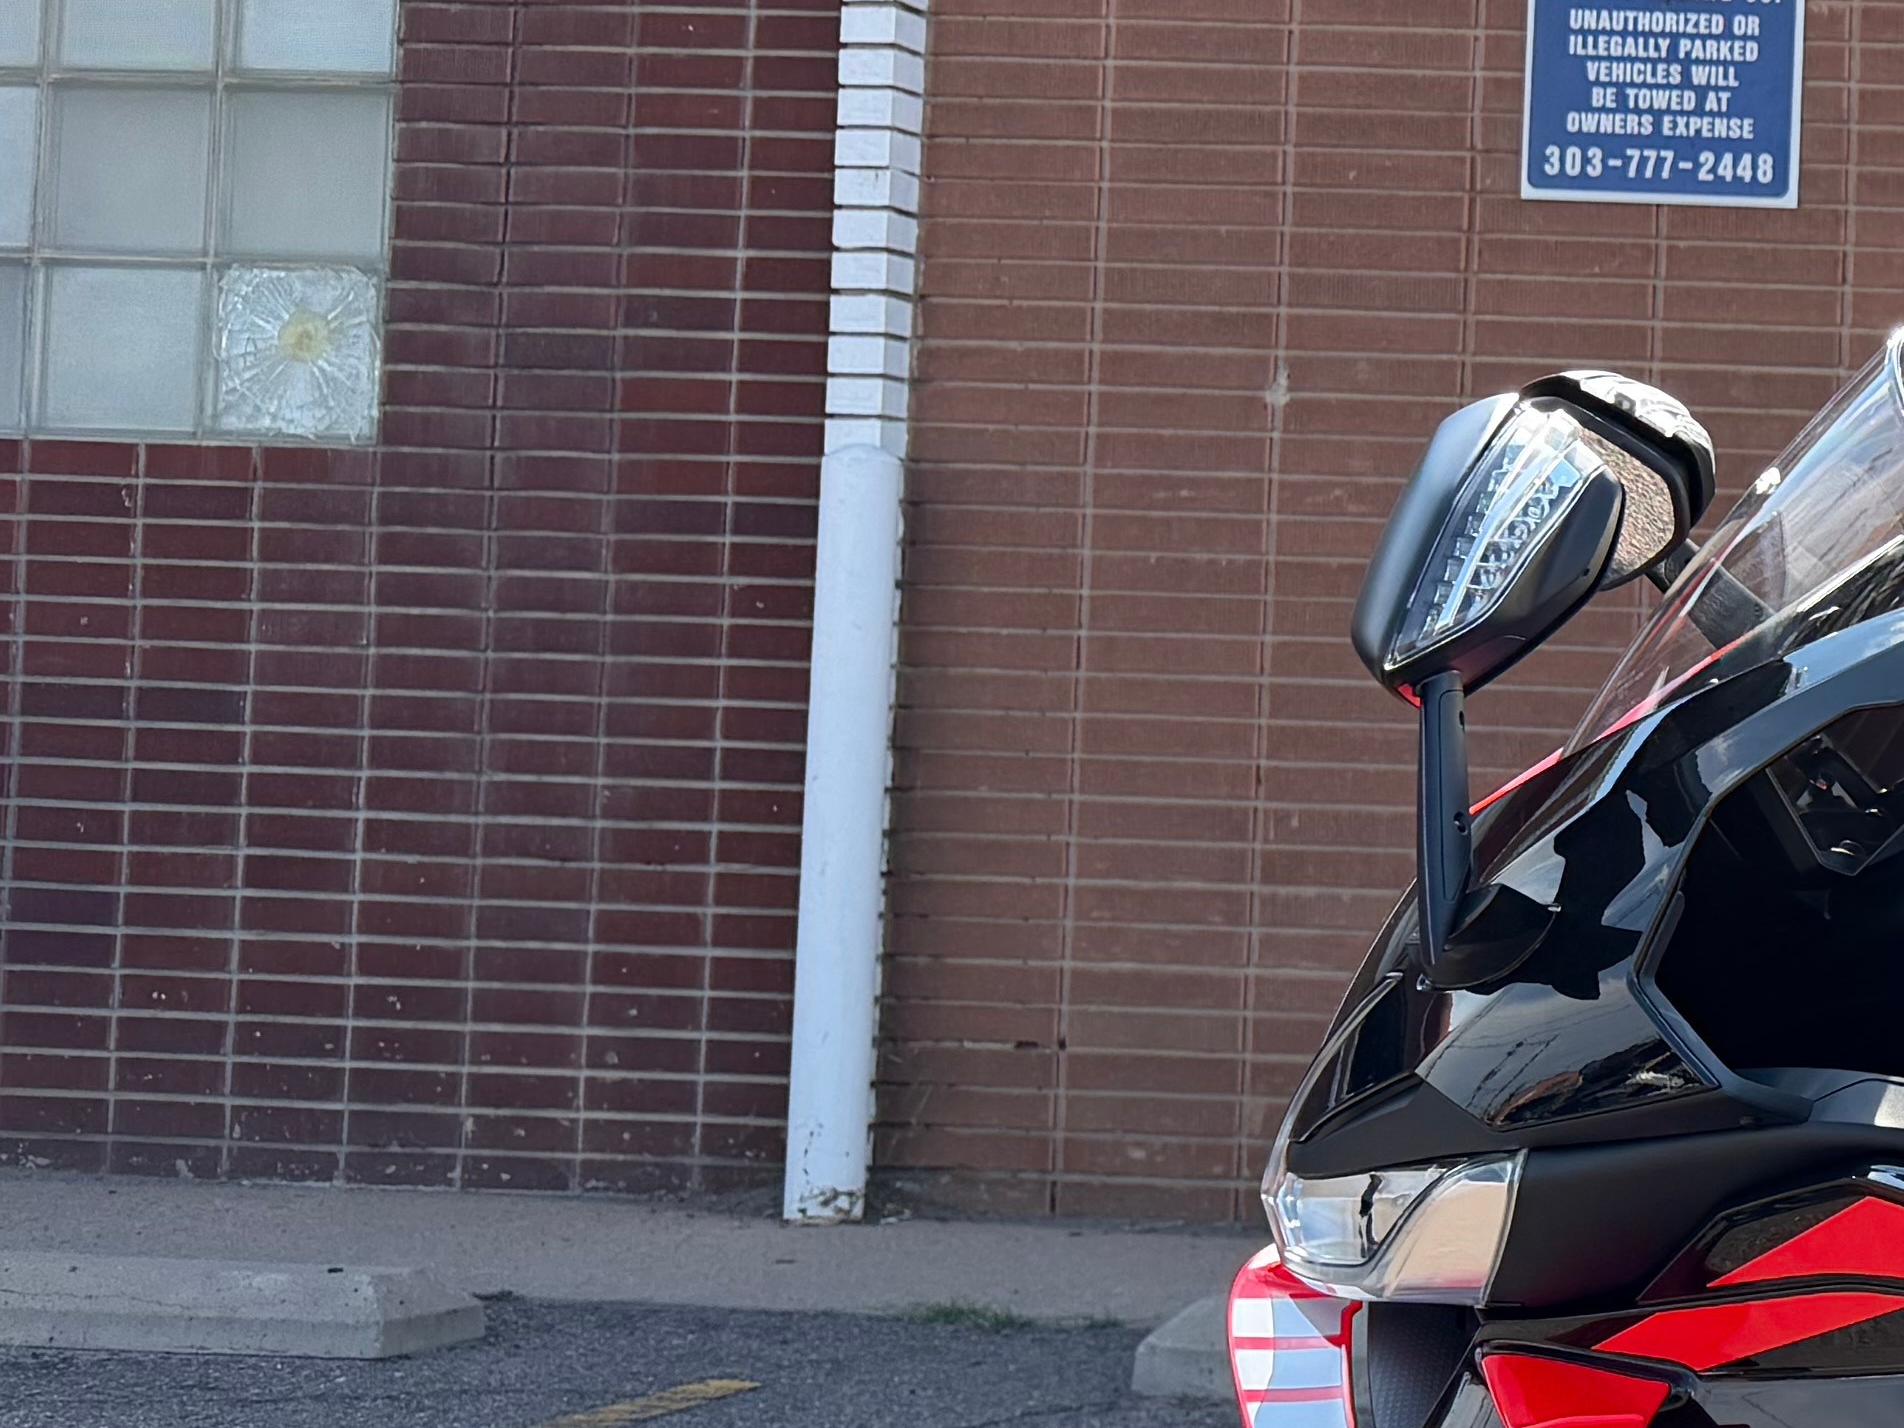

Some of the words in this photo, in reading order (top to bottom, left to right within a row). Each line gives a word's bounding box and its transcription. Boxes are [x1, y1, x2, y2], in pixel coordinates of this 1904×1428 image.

[1569, 9, 1725, 36] UNAUTHORIZED
[1732, 14, 1760, 37] OR
[1568, 34, 1671, 59] ILLEGALLY
[1678, 38, 1760, 62] PARKED
[1586, 61, 1682, 86] VEHICLES
[1691, 64, 1740, 88] WILL
[1591, 86, 1617, 109] BE
[1625, 88, 1697, 112] TOWED
[1704, 91, 1732, 112] AT
[1566, 111, 1654, 136] OWNERS
[1662, 115, 1755, 140] EXPENSE
[1544, 144, 1775, 185] 303-777-2448
